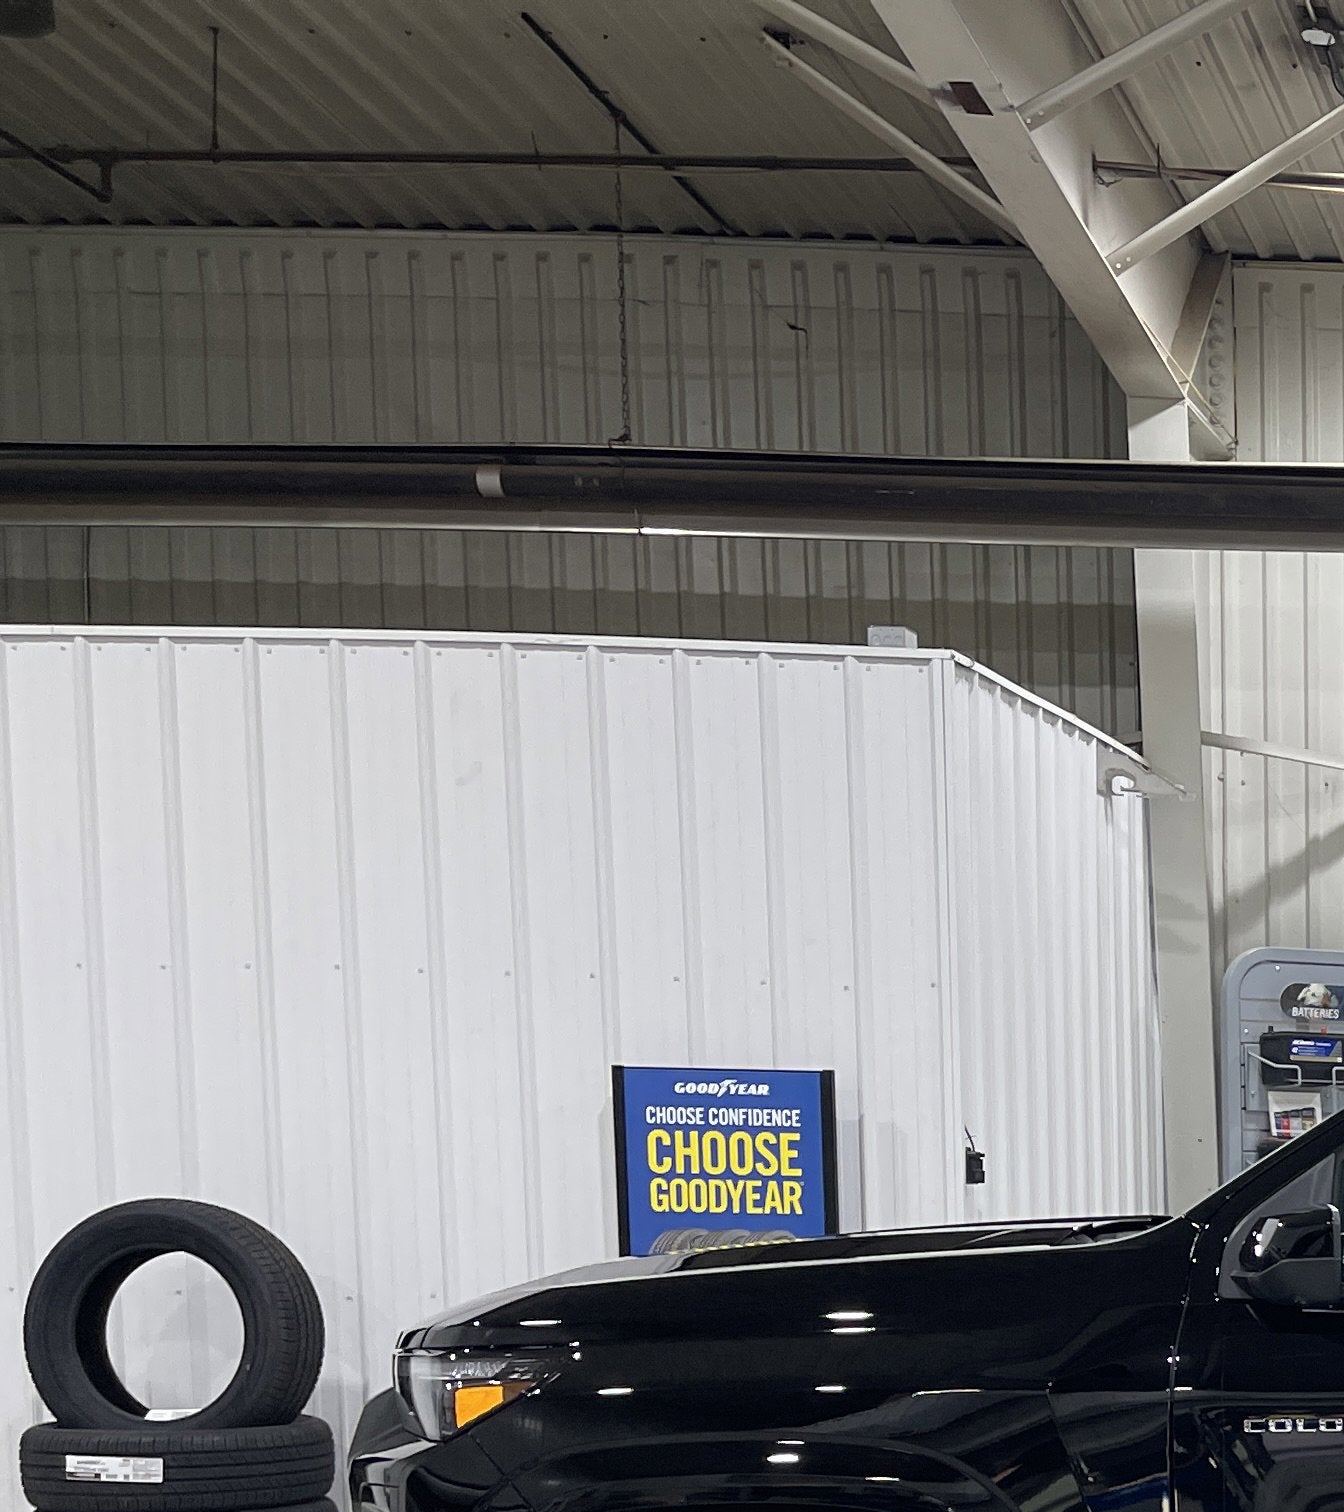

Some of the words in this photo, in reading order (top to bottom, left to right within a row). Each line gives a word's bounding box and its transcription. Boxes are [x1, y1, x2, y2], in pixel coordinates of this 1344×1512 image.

[1291, 1006, 1340, 1019] BATTERIES
[674, 1079, 770, 1097] GOODYEAR
[645, 1106, 705, 1125] CHOOSE
[708, 1107, 801, 1127] CONFIDENCE
[647, 1128, 802, 1176] CHOOSE
[650, 1178, 803, 1215] GOODYEAR
